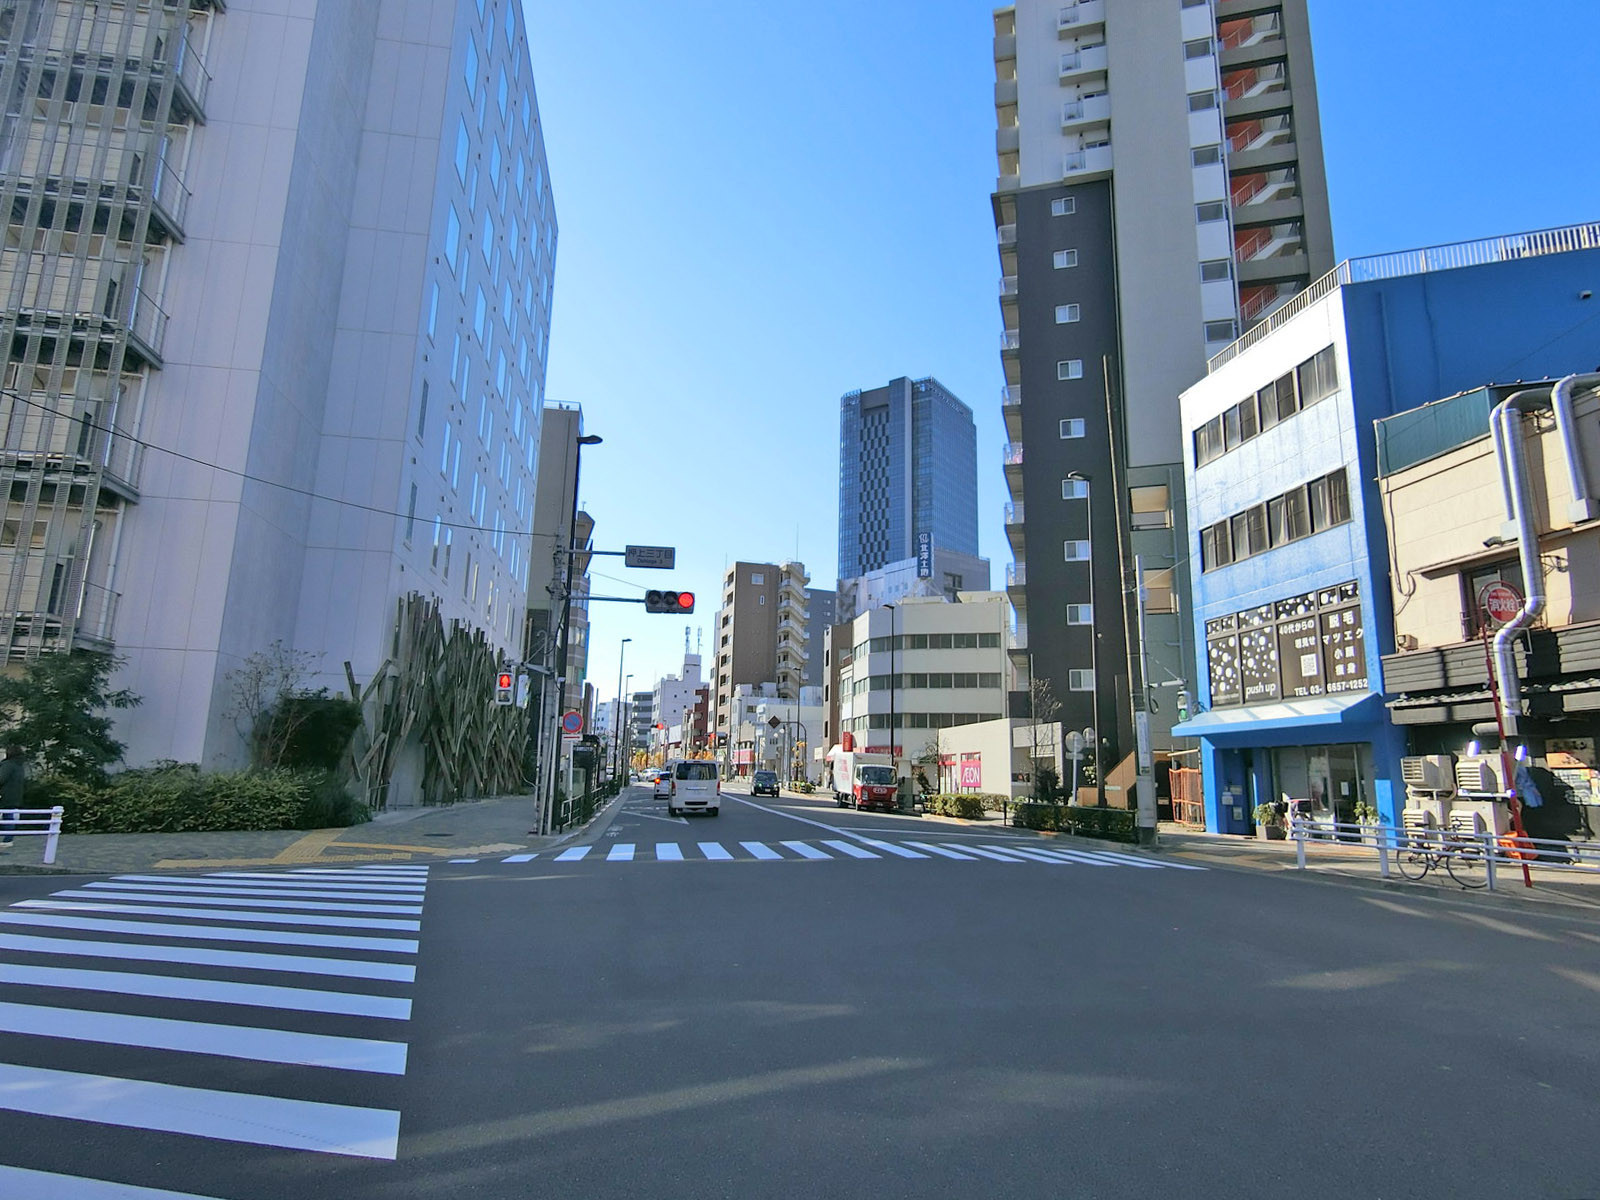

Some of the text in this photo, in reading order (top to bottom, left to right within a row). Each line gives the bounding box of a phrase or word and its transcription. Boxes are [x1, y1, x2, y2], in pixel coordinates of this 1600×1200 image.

[628, 549, 673, 559] 押上三丁目
[1489, 598, 1517, 612] 消火栓
[1328, 611, 1354, 628] 脱毛
[1279, 620, 1315, 635] 40代からの
[1322, 628, 1364, 645] マツエク
[1246, 682, 1264, 699] push
[1265, 683, 1276, 696] up
[1294, 686, 1309, 696] TEL
